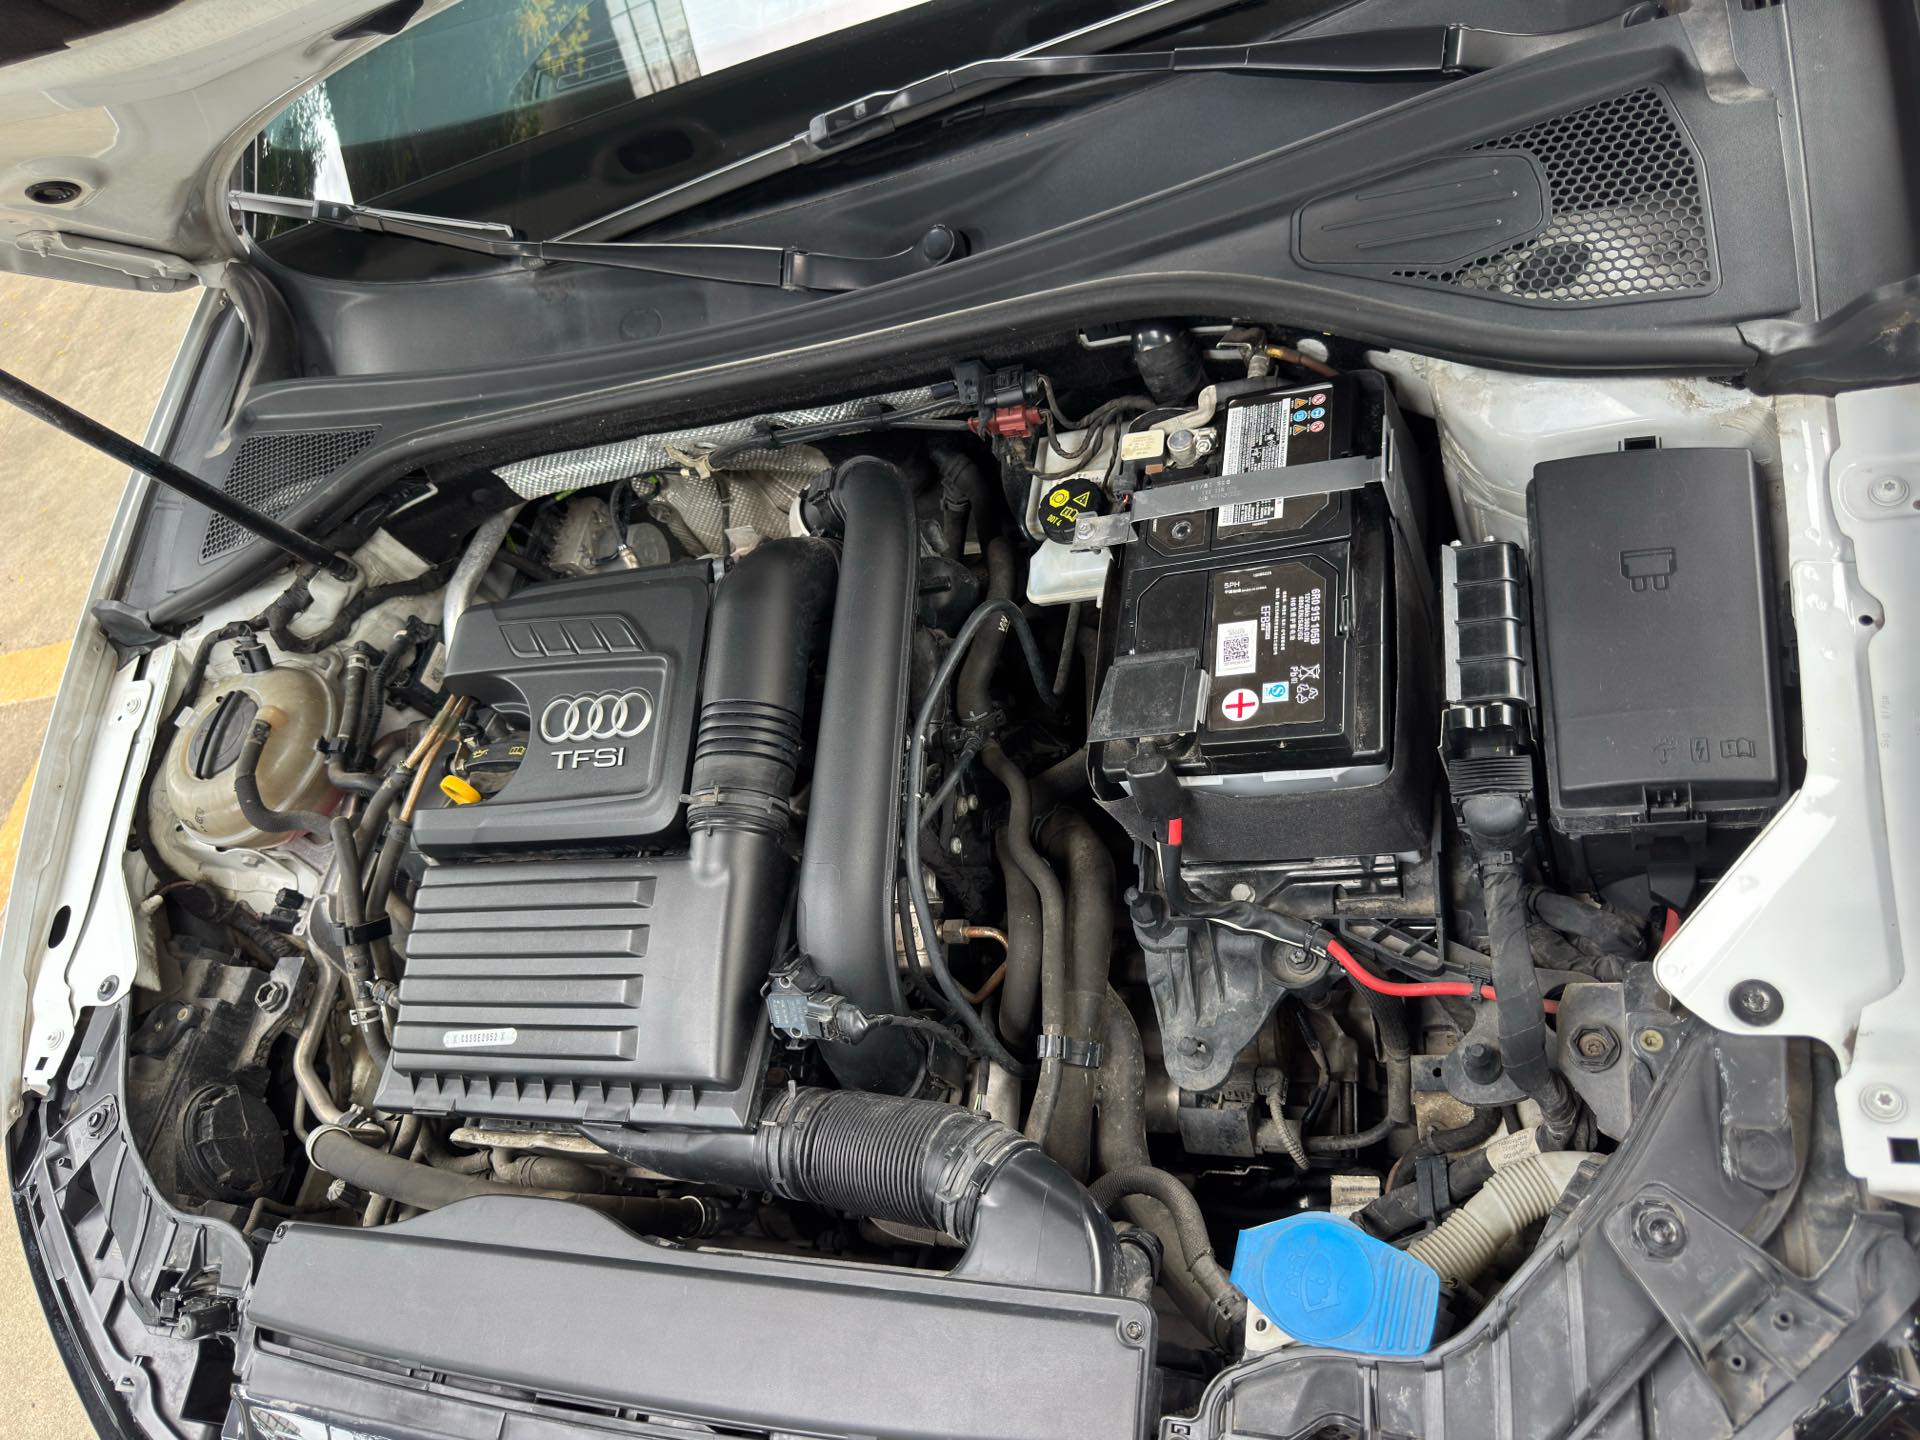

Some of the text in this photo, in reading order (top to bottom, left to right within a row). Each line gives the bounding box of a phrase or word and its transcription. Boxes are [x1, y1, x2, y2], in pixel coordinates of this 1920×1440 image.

[1046, 514, 1062, 527] DOT 4
[1260, 605, 1271, 623] EFB
[1310, 588, 1321, 645] 6R0 915 105B
[1289, 666, 1299, 677] Pb
[551, 747, 625, 769] TFSI
